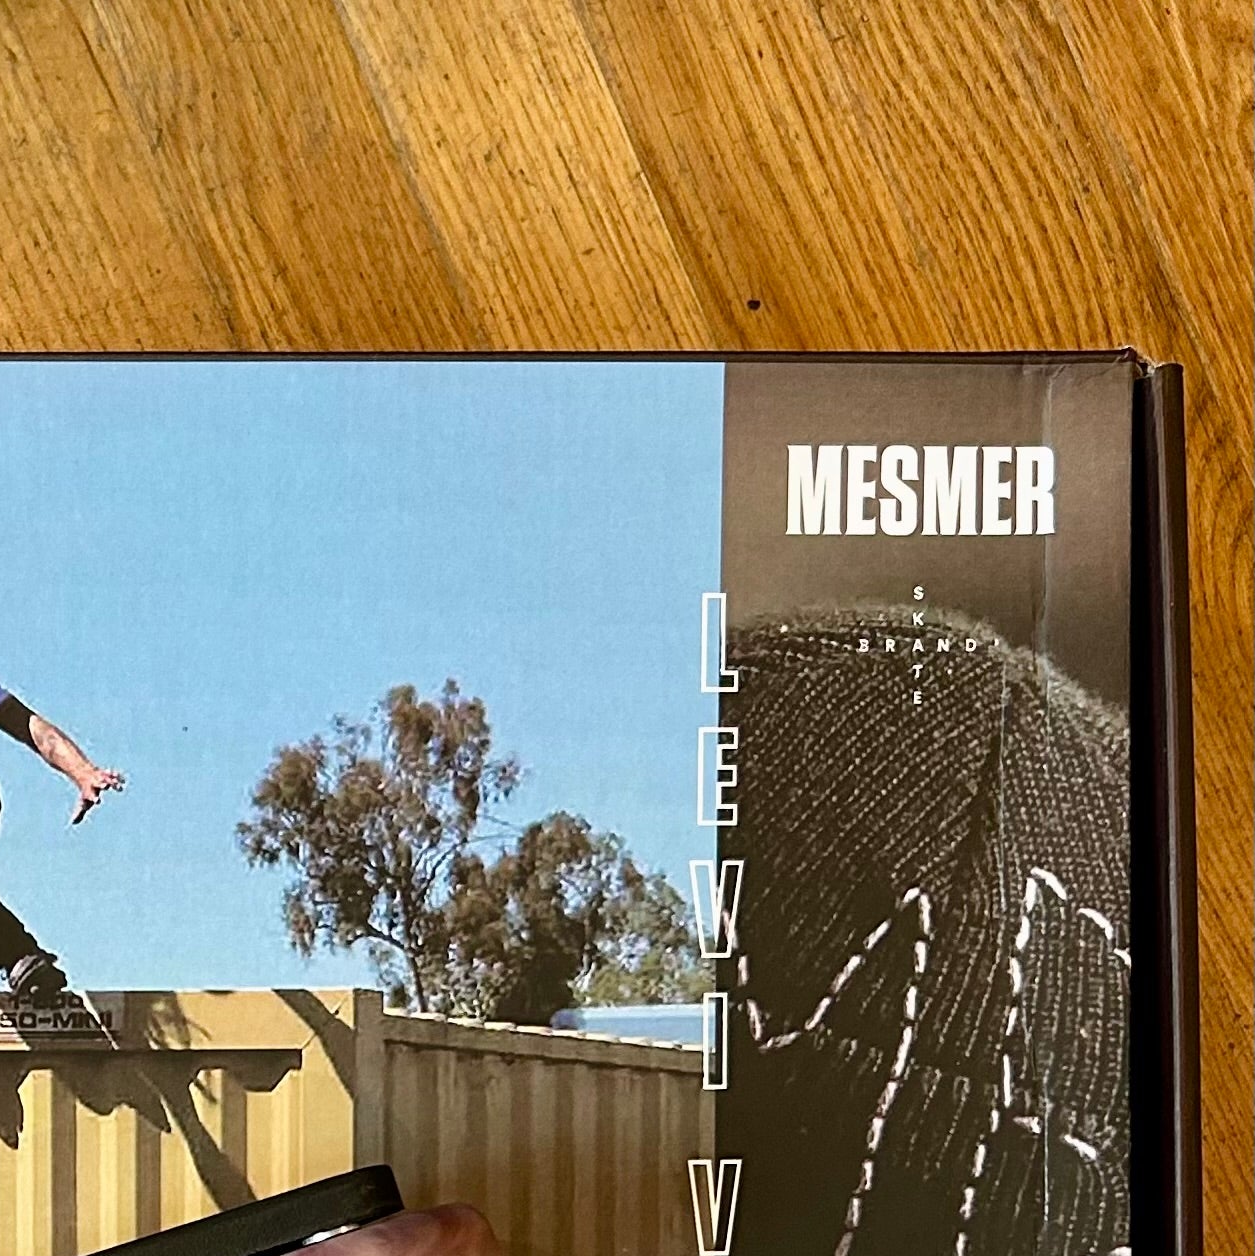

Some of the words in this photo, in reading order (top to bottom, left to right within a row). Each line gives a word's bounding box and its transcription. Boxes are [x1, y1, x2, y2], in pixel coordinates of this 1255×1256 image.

[785, 444, 1055, 536] MESMER
[858, 637, 978, 653] BRAND
[912, 585, 925, 705] SKATE
[689, 592, 744, 1090] LEVI
